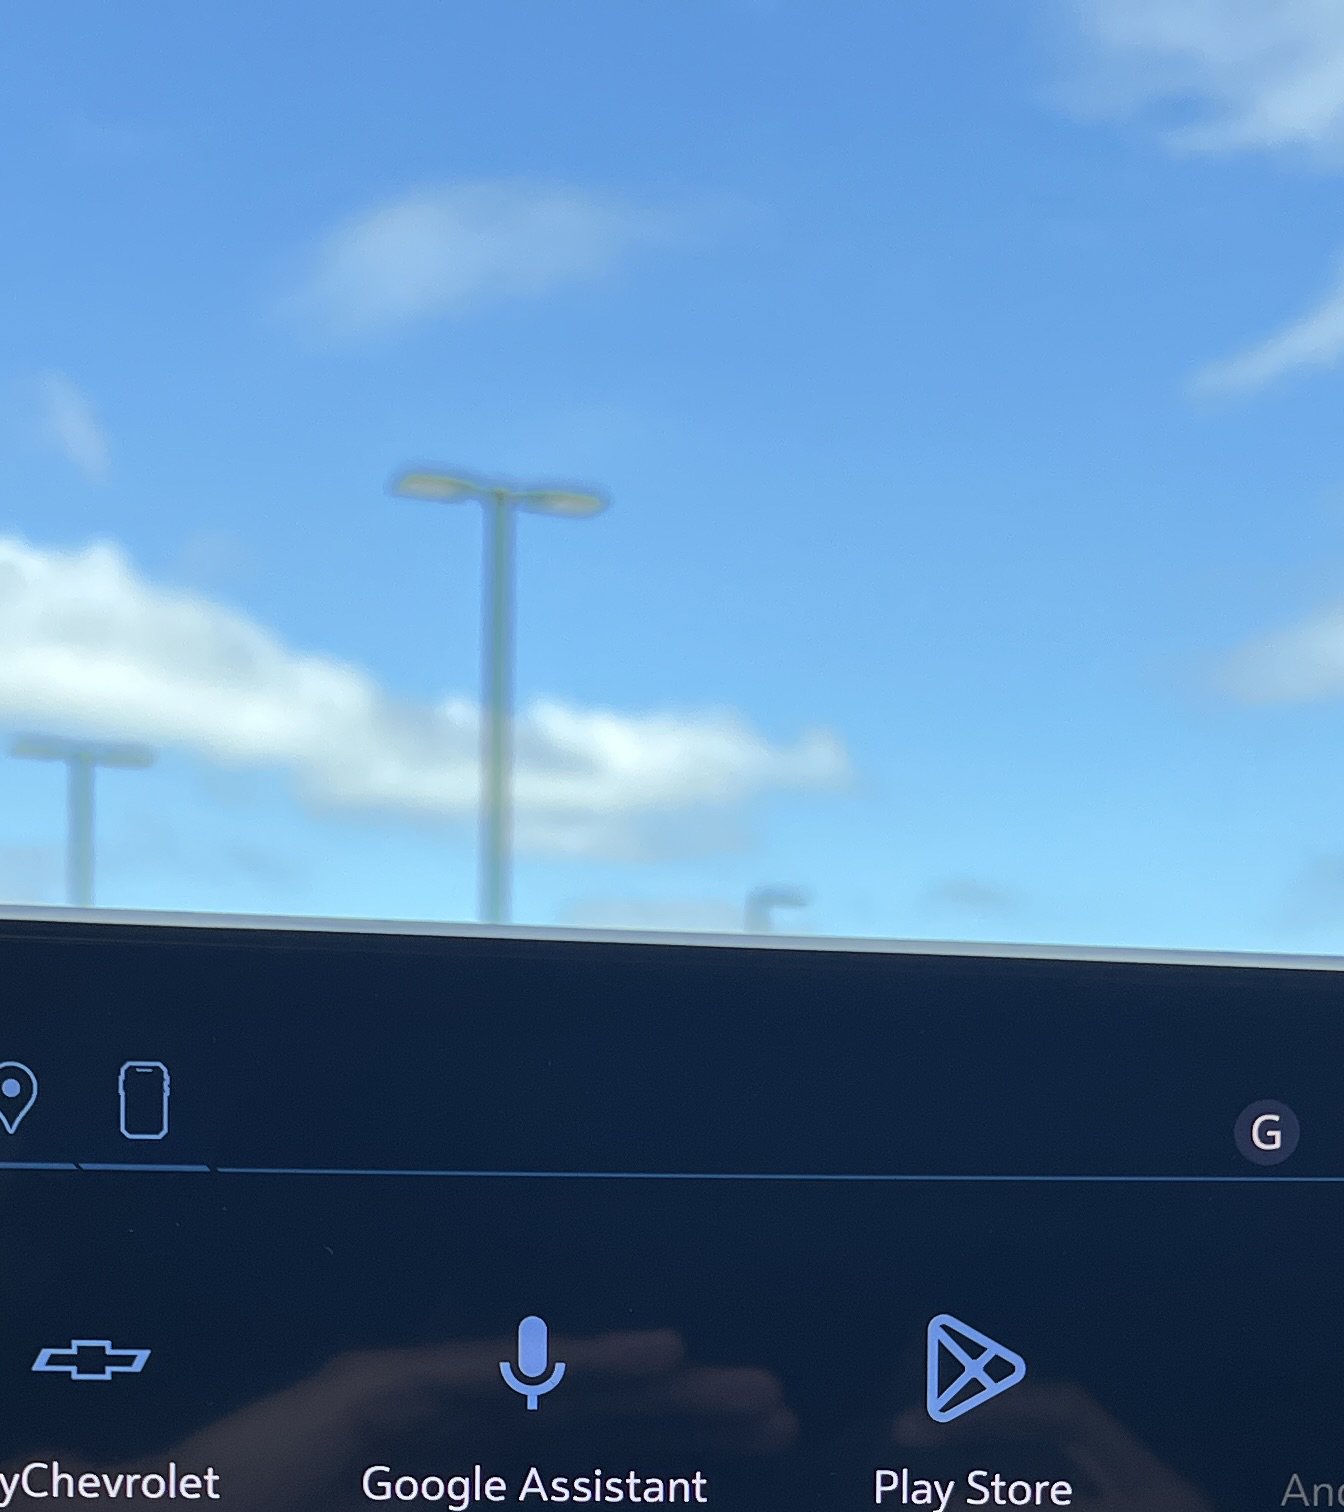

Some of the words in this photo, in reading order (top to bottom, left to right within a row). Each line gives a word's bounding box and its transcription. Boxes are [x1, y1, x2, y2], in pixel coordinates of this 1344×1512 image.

[1253, 1115, 1281, 1149] G
[362, 1464, 507, 1512] Google
[519, 1466, 708, 1503] Assistant
[967, 1470, 1073, 1506] Store
